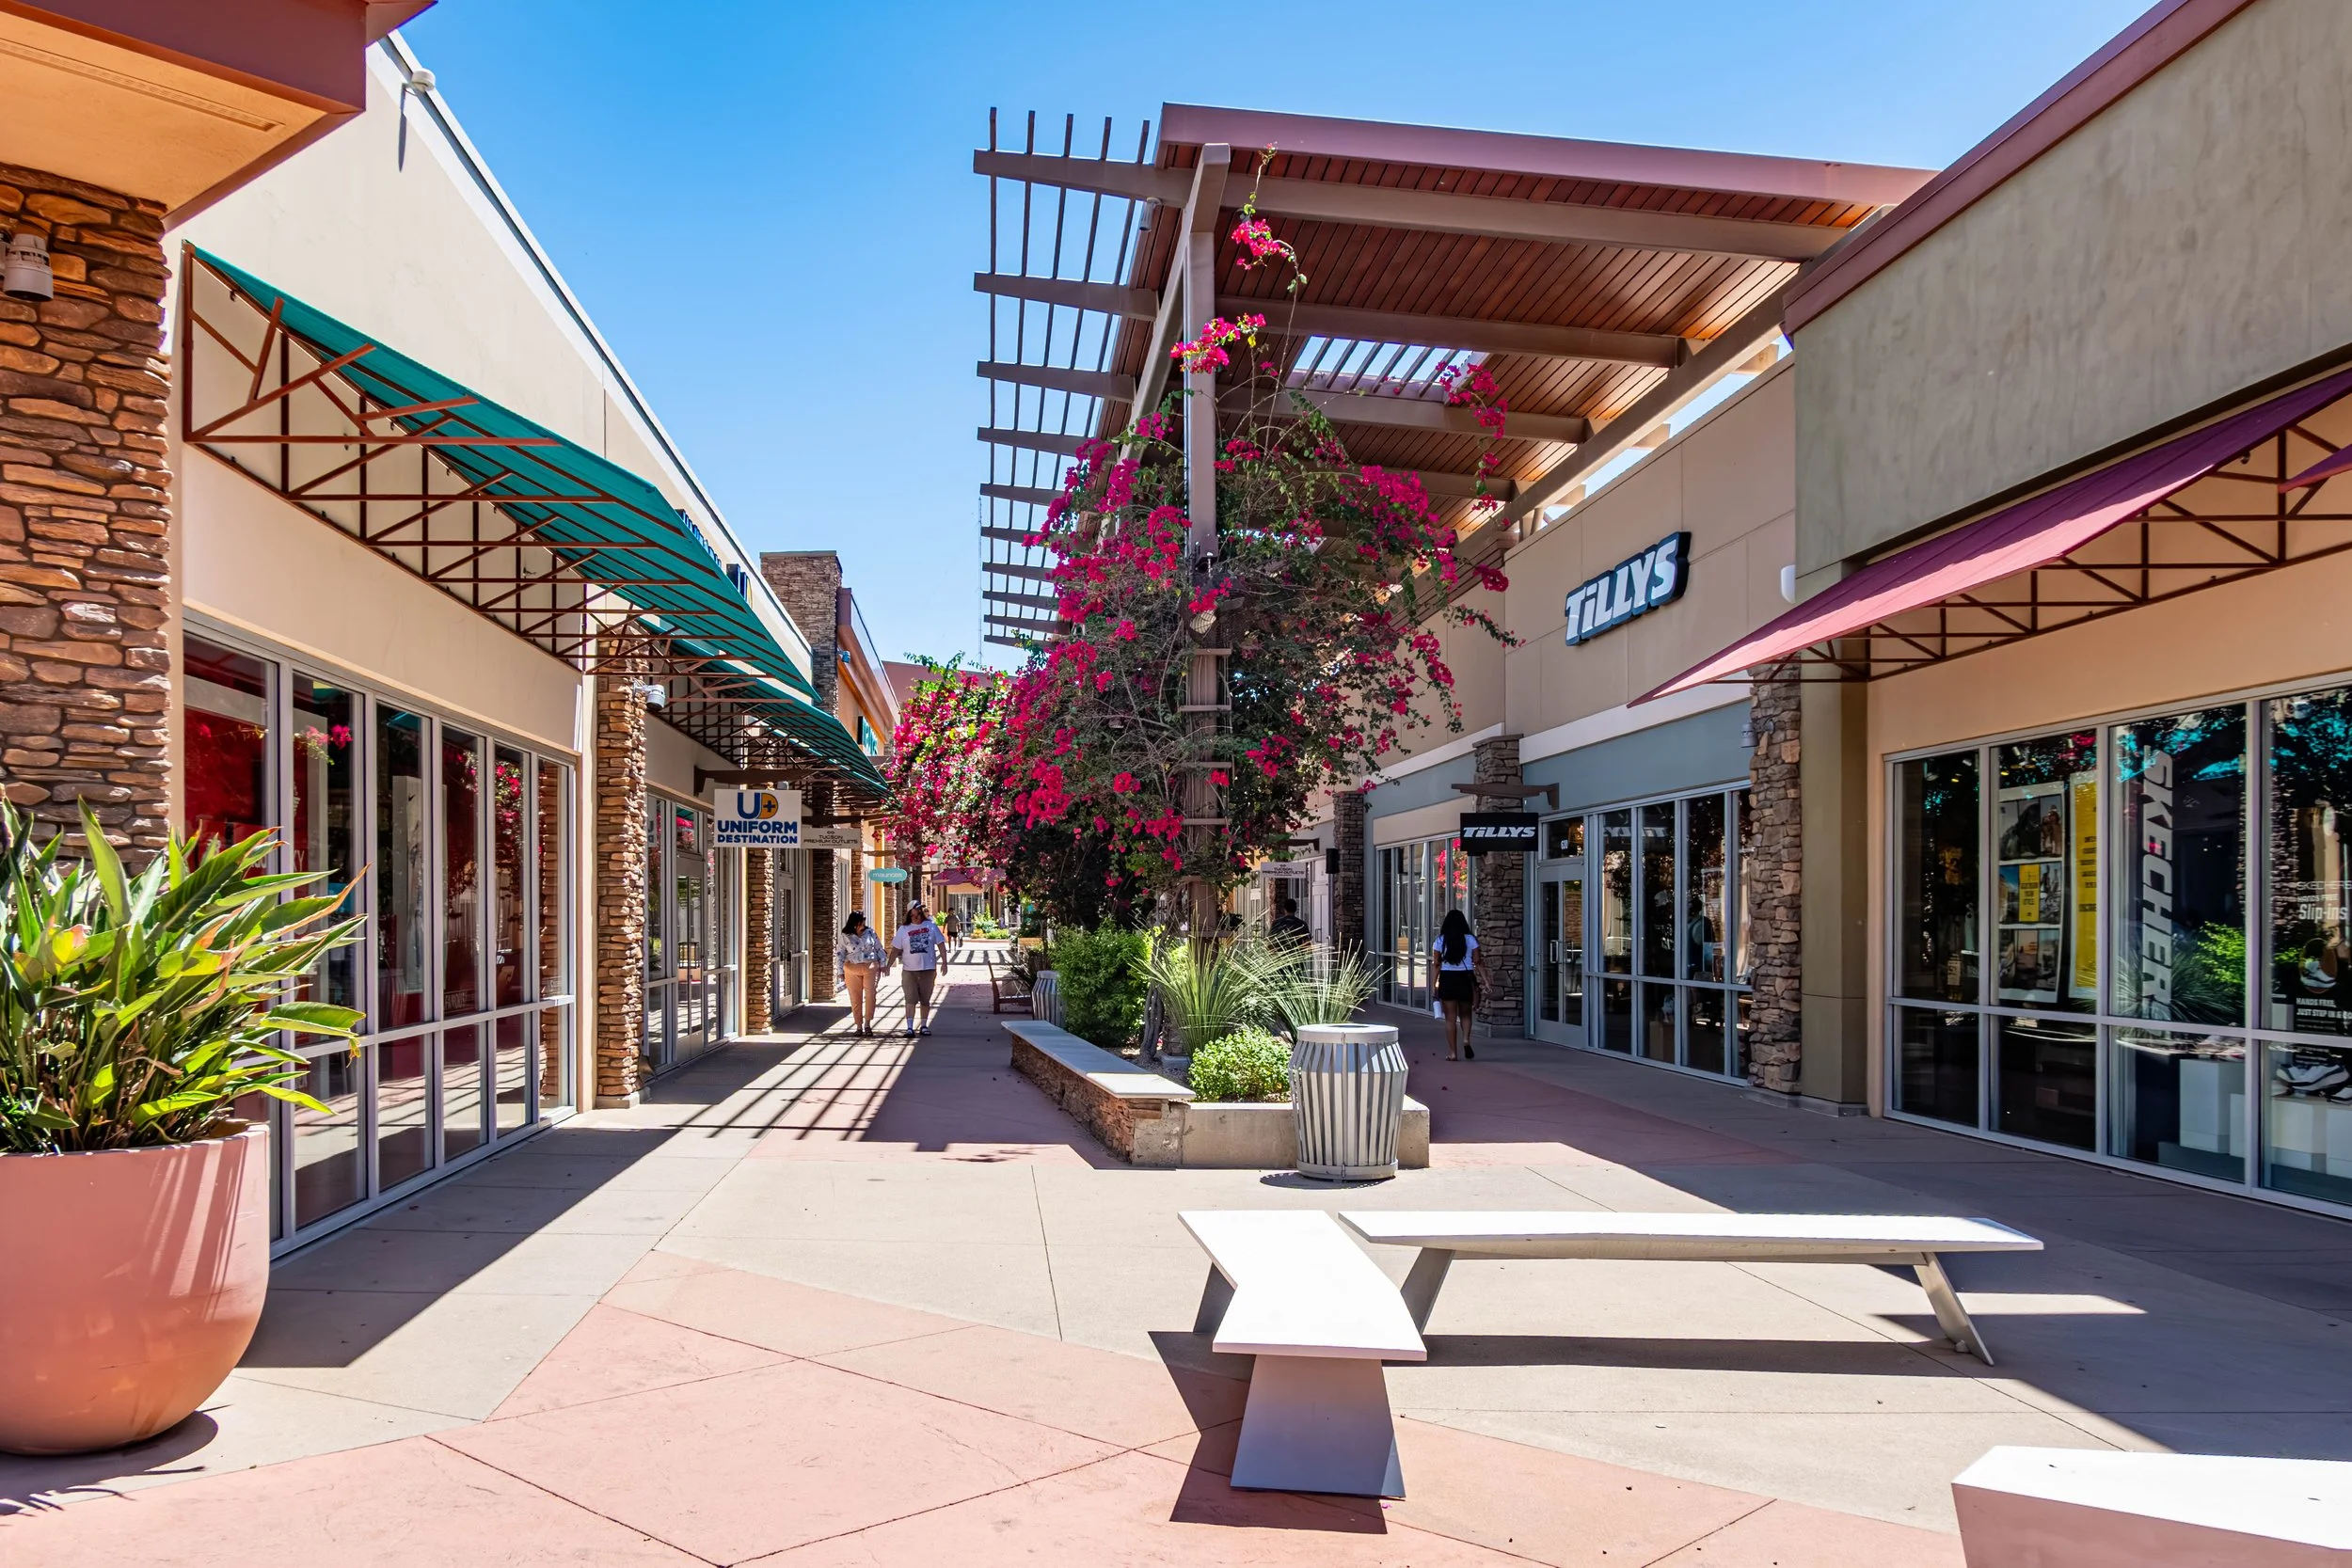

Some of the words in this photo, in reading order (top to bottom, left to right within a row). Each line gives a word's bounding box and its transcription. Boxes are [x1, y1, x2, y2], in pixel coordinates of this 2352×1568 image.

[717, 819, 798, 834] UNIFORM
[717, 834, 798, 845] DESTINATION
[2298, 903, 2348, 924] Slip-ins
